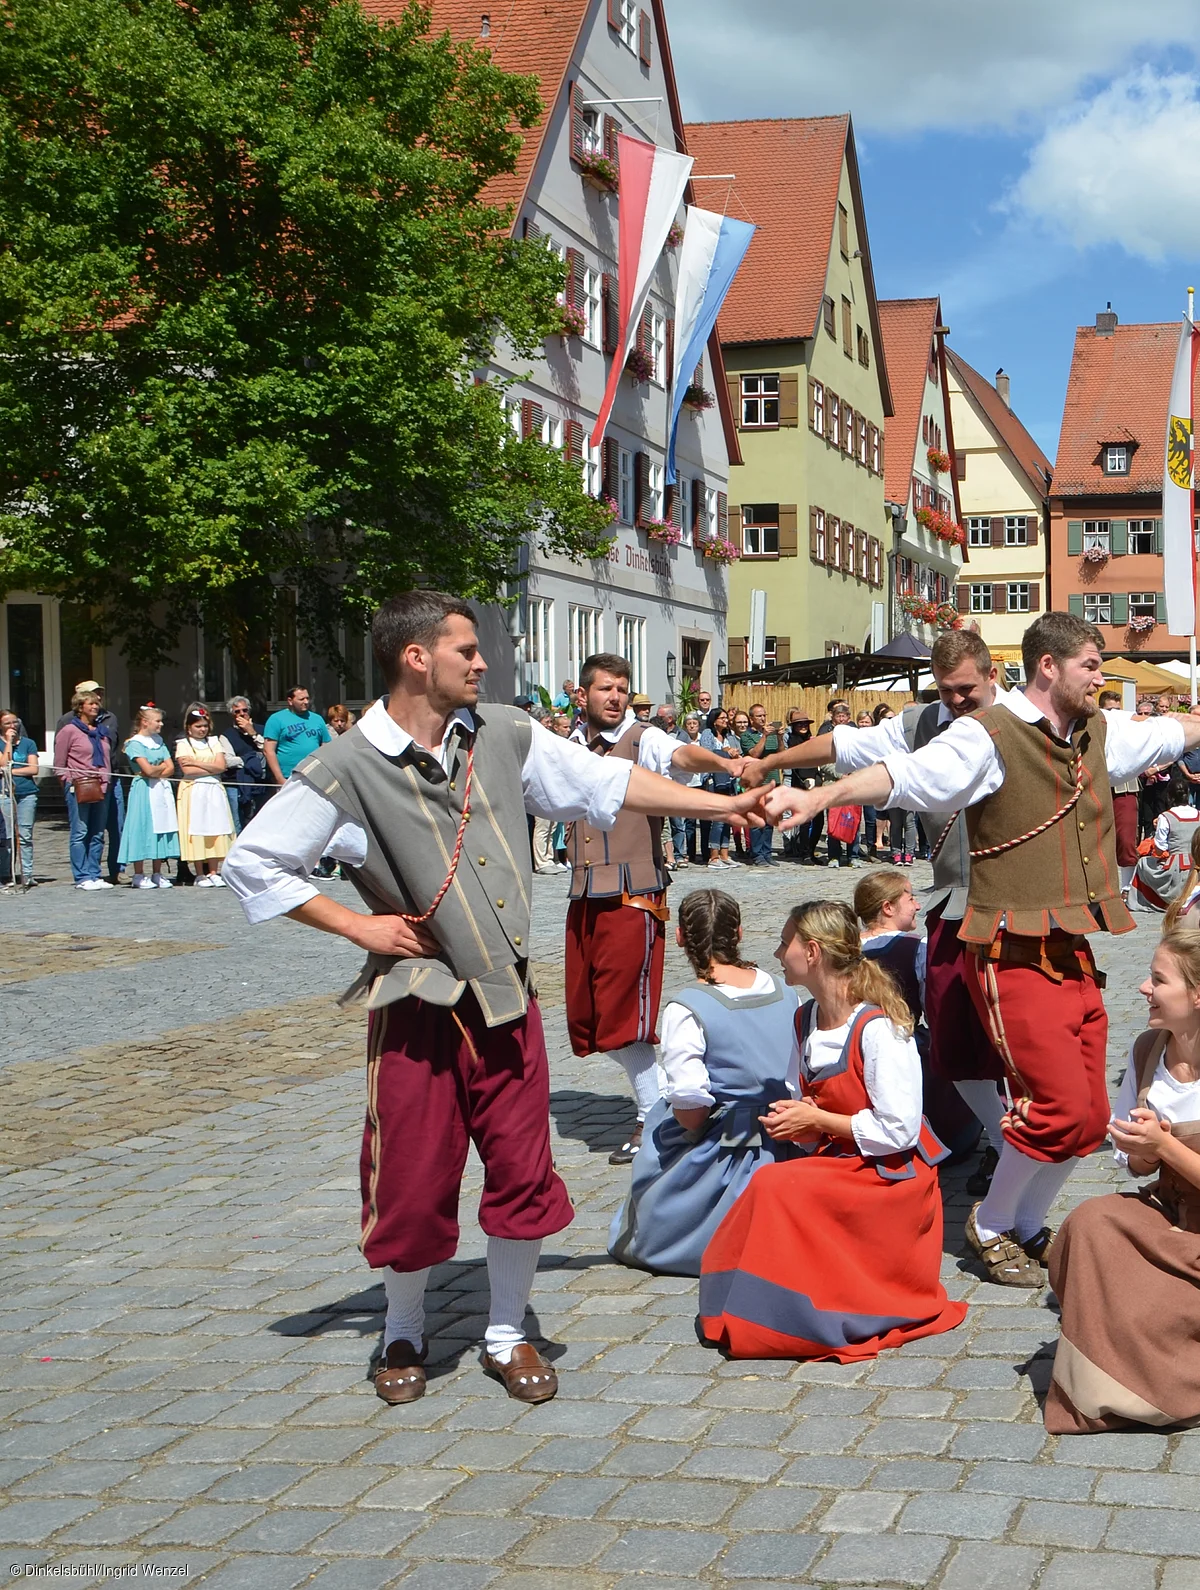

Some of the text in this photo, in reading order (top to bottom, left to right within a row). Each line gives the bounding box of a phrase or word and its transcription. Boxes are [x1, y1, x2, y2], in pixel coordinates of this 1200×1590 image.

[625, 544, 672, 581] Dinkelsbühl
[286, 722, 307, 735] JUST
[305, 728, 317, 739] DO
